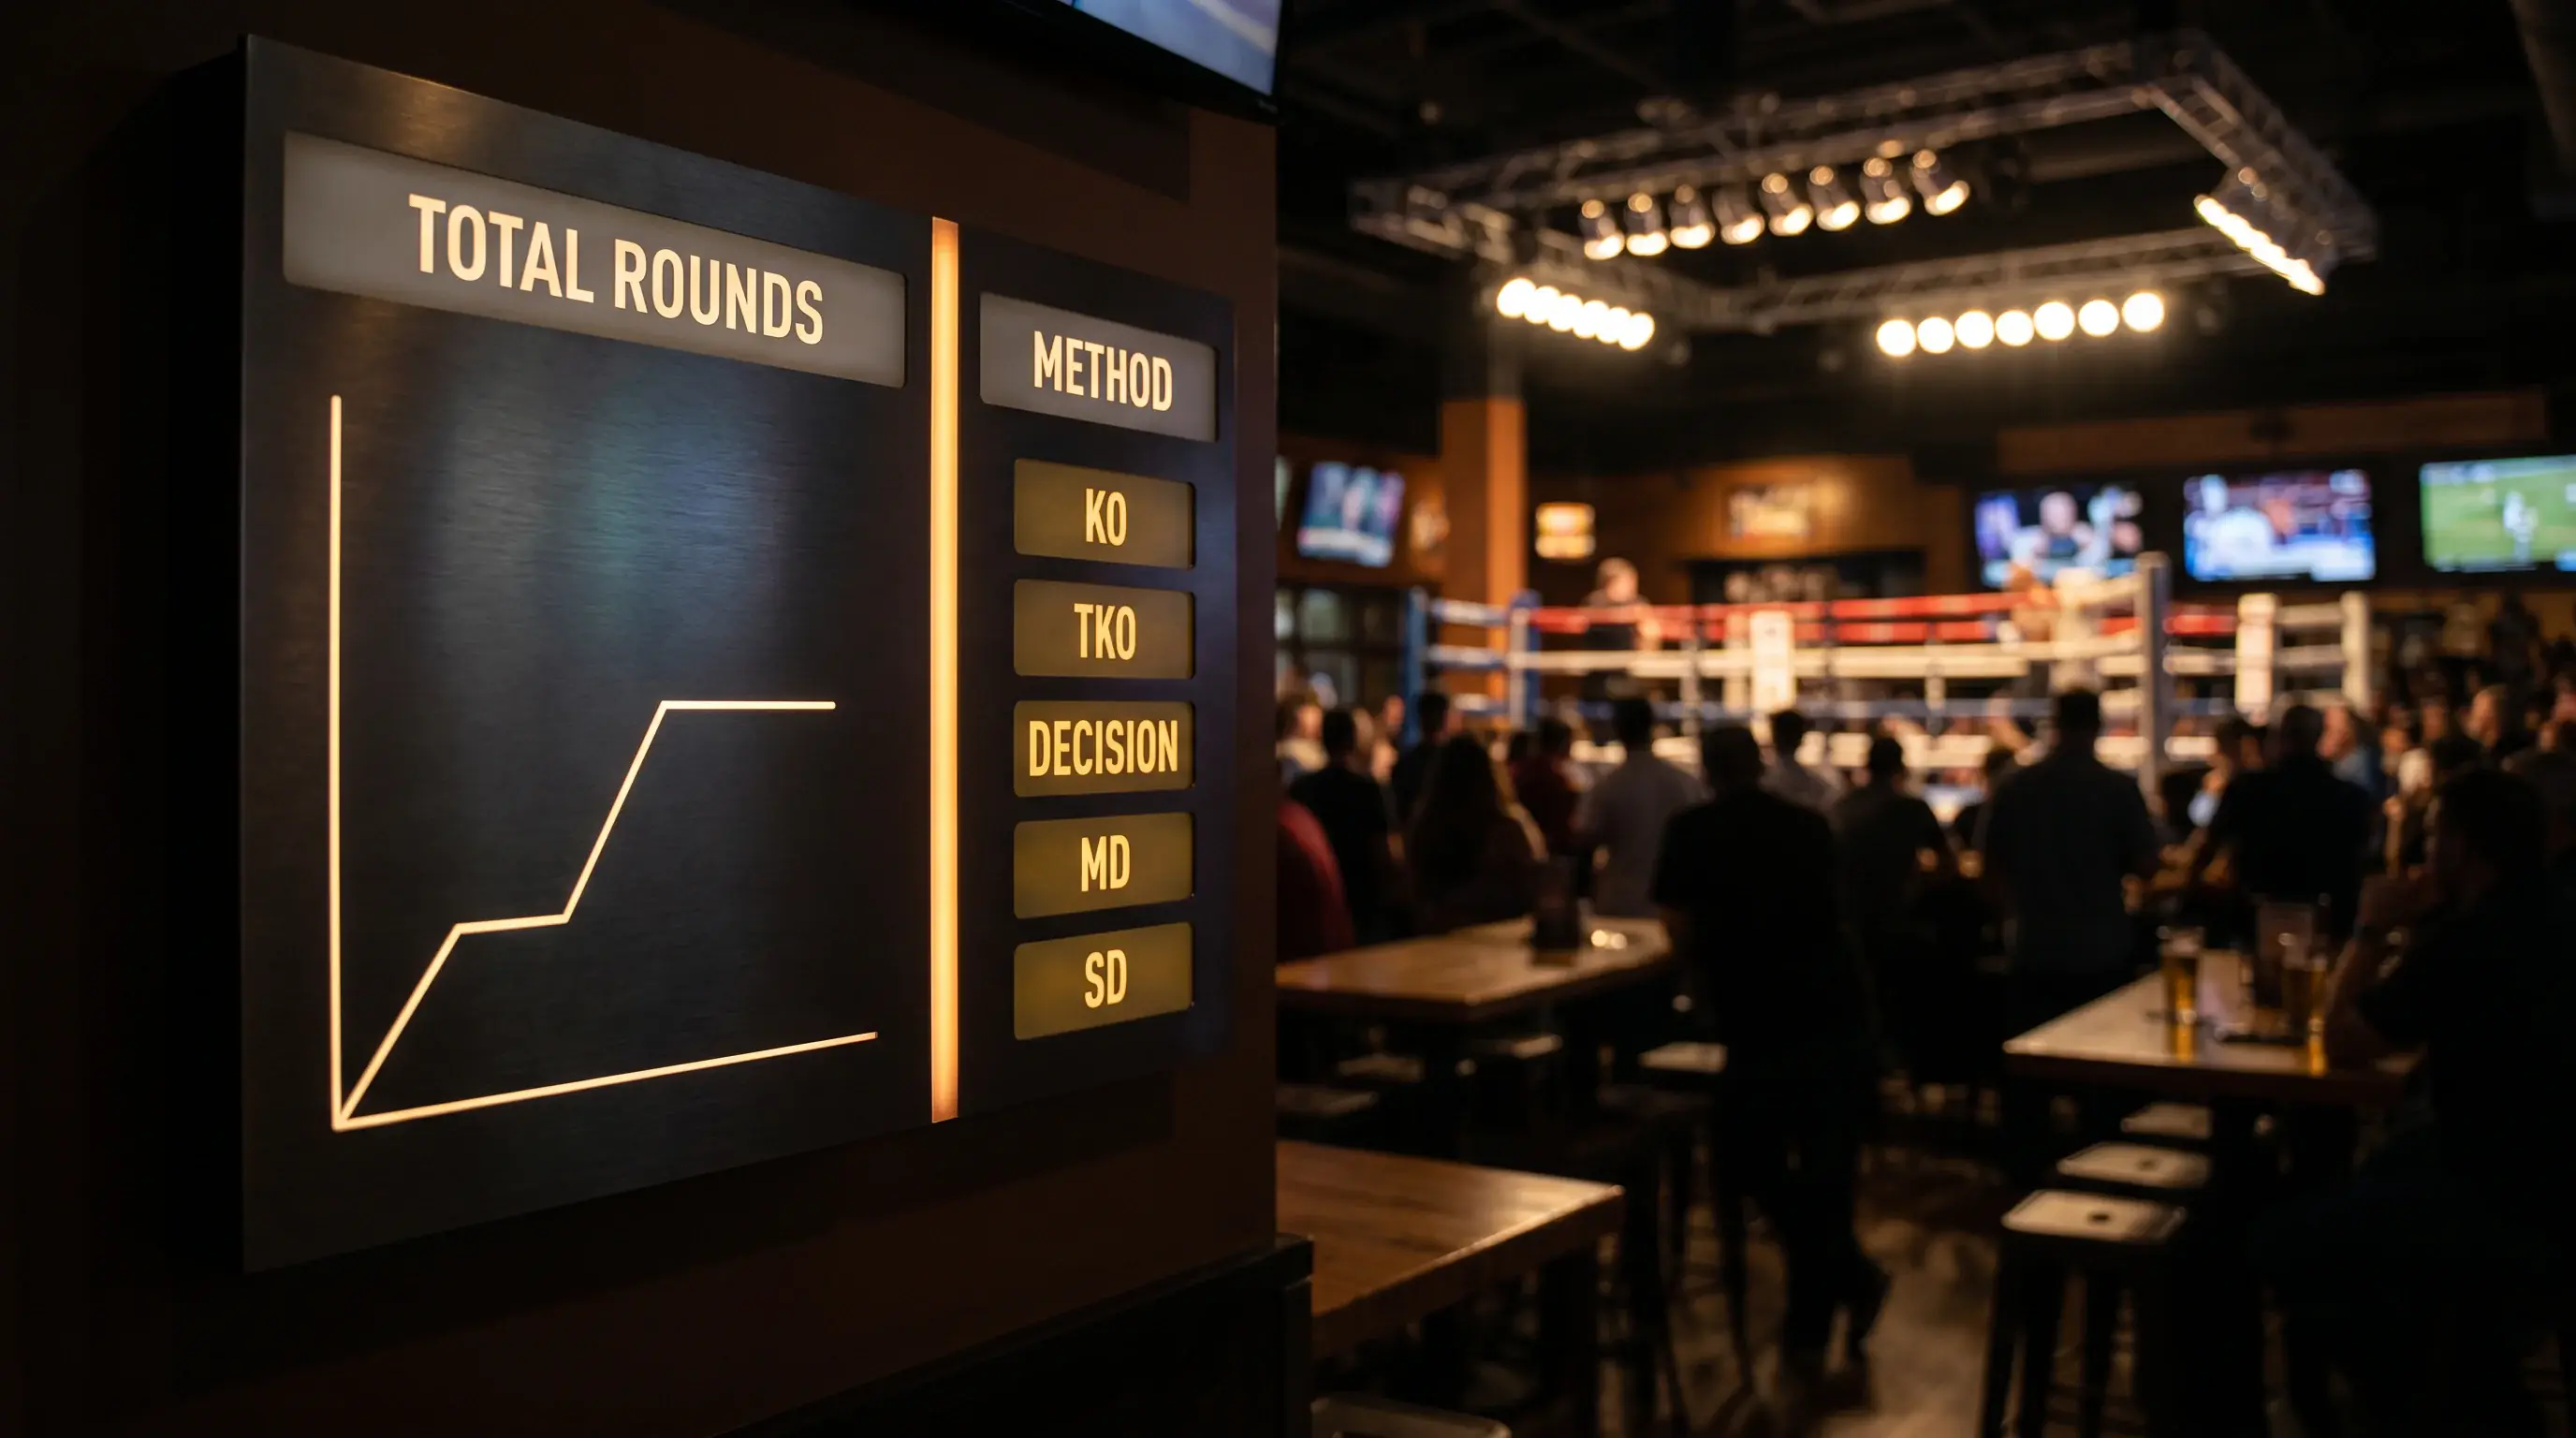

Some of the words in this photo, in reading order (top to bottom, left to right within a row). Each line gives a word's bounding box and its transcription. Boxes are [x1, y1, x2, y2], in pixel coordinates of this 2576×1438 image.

[408, 193, 594, 303] TOTAL
[614, 238, 823, 345] ROUNDS
[1033, 330, 1173, 411] METHOD
[1086, 488, 1127, 546] KO
[1074, 603, 1136, 661] TKO
[1029, 719, 1178, 777] DECISION
[1081, 834, 1131, 892] MD
[1084, 948, 1127, 1008] SD
